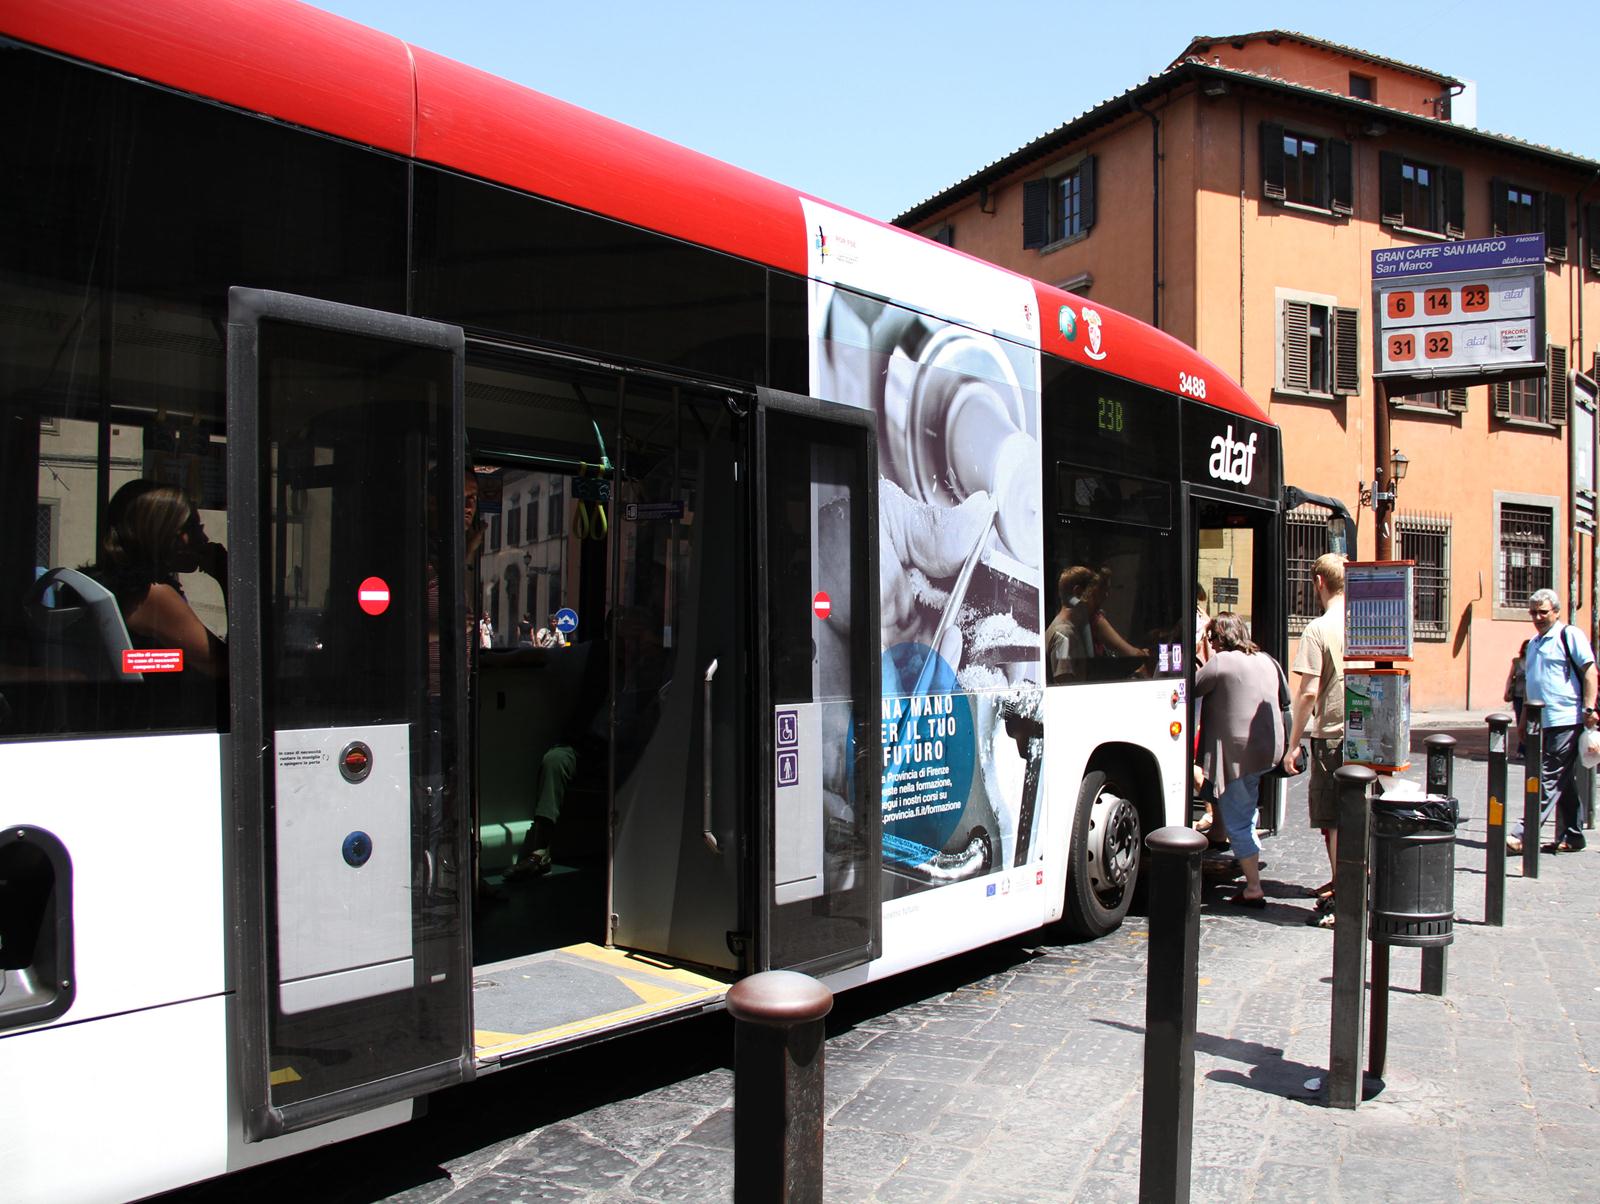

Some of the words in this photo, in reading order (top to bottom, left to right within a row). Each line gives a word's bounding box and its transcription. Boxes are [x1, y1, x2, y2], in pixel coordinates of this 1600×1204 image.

[1375, 251, 1405, 263] GRAN
[1406, 247, 1442, 260] CAFFE'
[1443, 245, 1465, 257] SAN
[1466, 241, 1506, 255] MARCO
[1375, 263, 1397, 274] San
[1398, 261, 1433, 272] Marco
[1396, 298, 1406, 313] 6
[1429, 294, 1449, 309] 14
[1465, 291, 1487, 307] 23
[1393, 340, 1412, 356] 31
[1429, 337, 1449, 353] 32
[1465, 335, 1488, 347] ataf
[1179, 371, 1207, 399] 3488
[1097, 396, 1124, 432] 23B
[1209, 425, 1258, 485] ataf
[910, 695, 953, 718] MANO
[907, 721, 921, 741] IL
[928, 716, 956, 738] TUO
[883, 741, 943, 767] FUTURO
[887, 770, 918, 783] Provincia
[918, 768, 925, 778] di
[926, 766, 949, 777] Firenze
[898, 782, 915, 794] nella
[915, 778, 953, 792] formazione,
[902, 794, 922, 806] nostri
[922, 792, 938, 803] corsi
[939, 791, 948, 801] su
